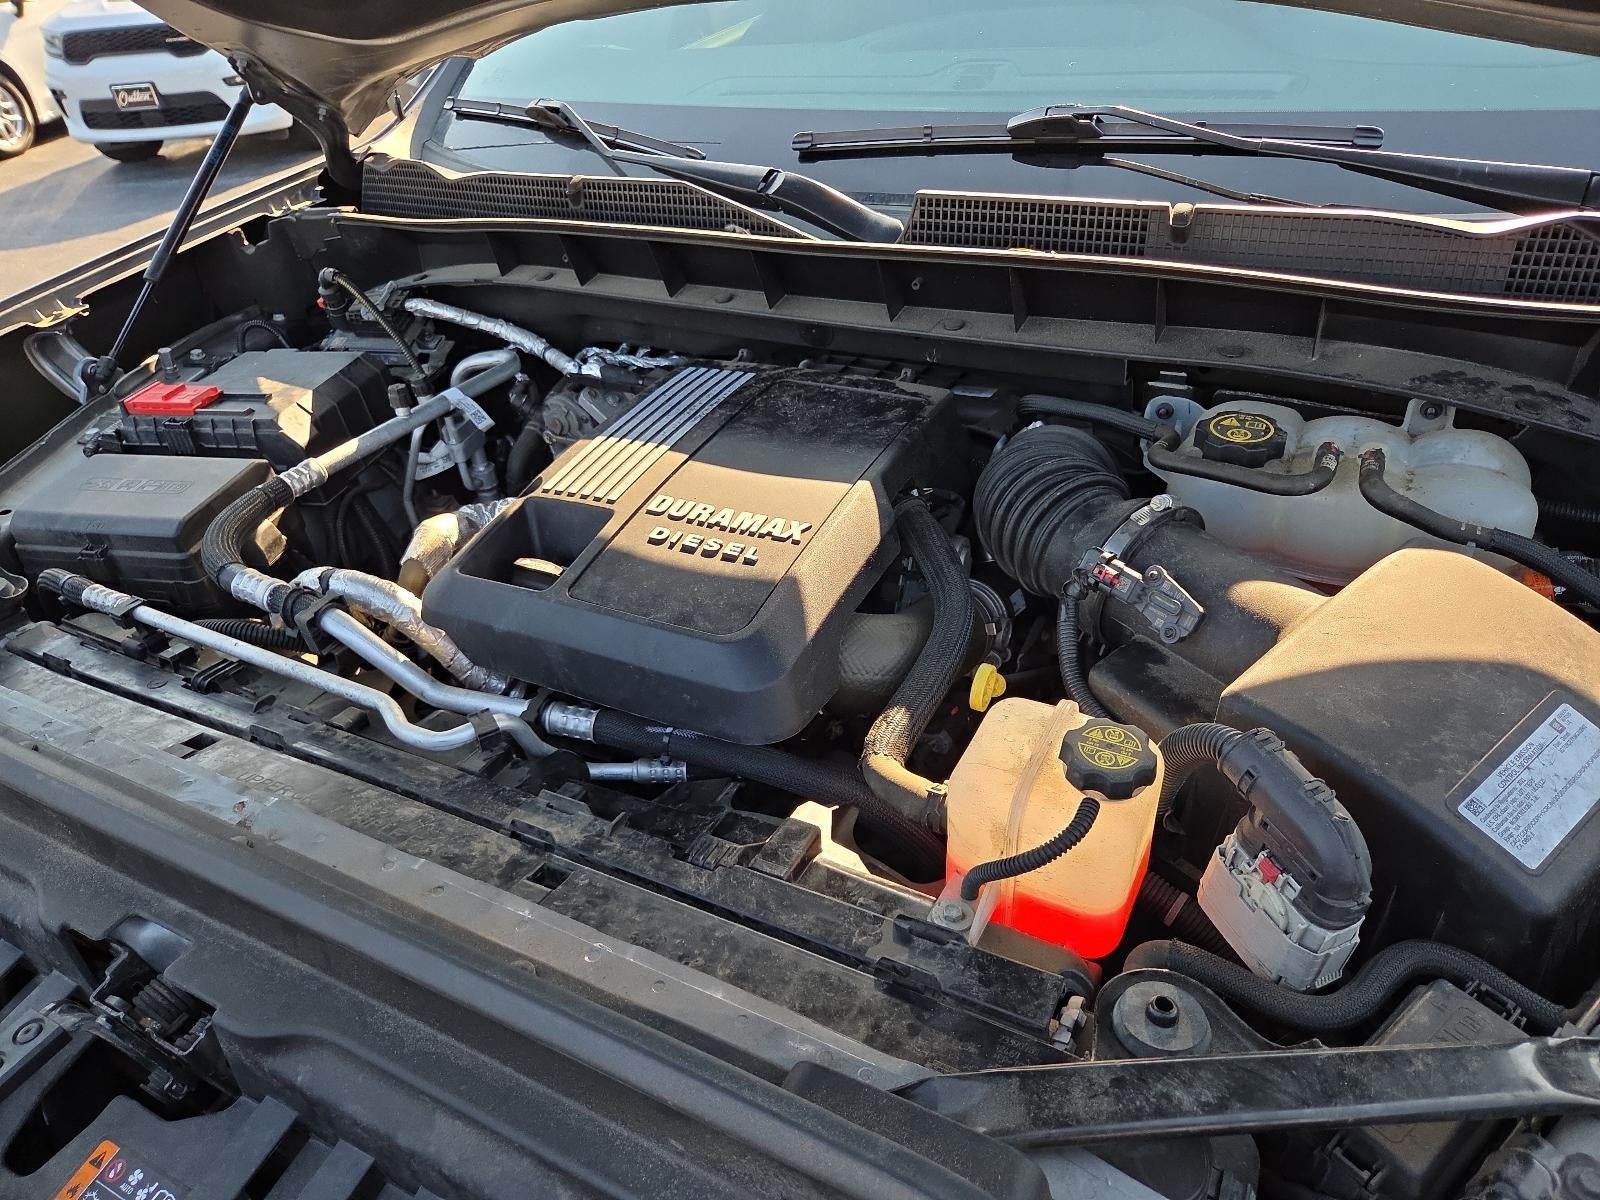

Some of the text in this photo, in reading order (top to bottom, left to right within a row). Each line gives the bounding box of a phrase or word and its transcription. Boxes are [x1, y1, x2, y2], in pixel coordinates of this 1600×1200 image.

[645, 494, 812, 545] DURAMAX
[647, 526, 759, 566] DIESEL
[1496, 766, 1520, 790] CONTROL
[119, 1183, 134, 1195] AUTO
